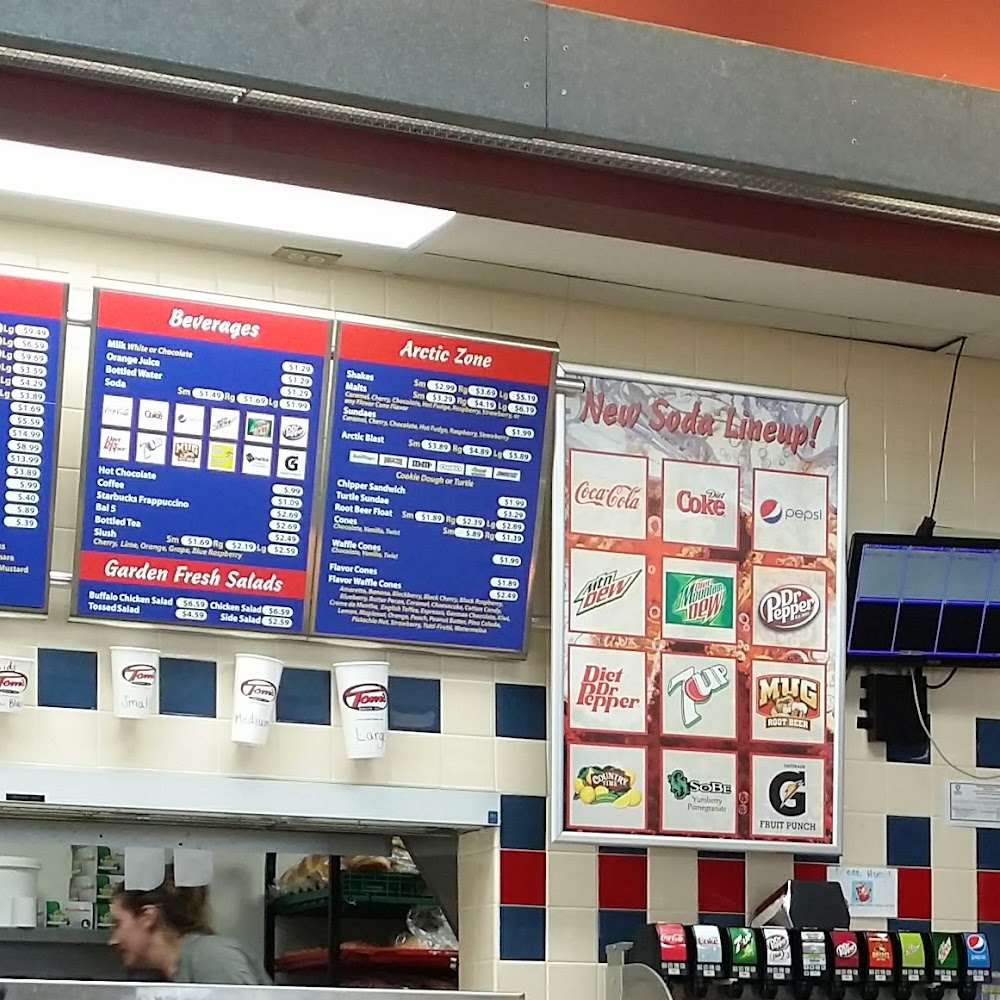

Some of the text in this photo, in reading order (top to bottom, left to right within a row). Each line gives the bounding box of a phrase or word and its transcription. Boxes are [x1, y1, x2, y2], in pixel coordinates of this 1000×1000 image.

[168, 308, 260, 340] Beverages
[107, 339, 311, 373] Milk Chocolate $1.29
[399, 340, 492, 369] Arctic Zone
[106, 353, 310, 385] Orange Juice $1.29
[346, 370, 456, 391] Shakes $2.99
[105, 365, 309, 397] Bottled Water $1.29
[105, 378, 308, 410] Soda $1.49 $1.69 $1.99
[345, 382, 495, 409] Malts $4.19
[18, 404, 41, 412] $1.69
[18, 417, 41, 426] $5.59
[343, 406, 532, 437] Sundaes $1.99
[579, 388, 822, 455] New Soda Lineup!
[12, 430, 41, 438] $14.99
[17, 443, 40, 451] $8.99
[341, 431, 529, 461] Arctic Blast $4.89 $5.89
[11, 455, 39, 464] $13.99
[14, 468, 37, 476] $3.89
[98, 466, 157, 481] Hot Chocolate
[396, 471, 444, 485] Cookie Dough
[20, 481, 38, 489] $.99
[97, 479, 300, 507] Coffee $1.09
[336, 479, 525, 507] Chipper Sandwich $1.99
[574, 480, 642, 511] Coca-Cola
[706, 488, 726, 500] Diet
[18, 493, 36, 501] $.40
[96, 491, 299, 519] Starbucks Frappuccino $2.69
[336, 491, 524, 518] Turtle Sundae $3.29
[676, 490, 726, 517] Coke
[17, 506, 35, 514] $.89
[333, 515, 357, 526] Cones
[334, 503, 394, 517] Root Beer Float
[785, 508, 822, 522] pepsi
[17, 519, 35, 527] $.39
[95, 515, 297, 543] Bottled Tea $2.49
[276, 522, 298, 531] $2.69
[94, 528, 296, 555] Slush $1.69 $2.59
[331, 539, 520, 565] Waffle Cones $1.99
[104, 559, 284, 593] Garden Fresh Salads
[329, 563, 377, 575] Flavor Cones
[328, 575, 516, 600] Flavor Waffle Cones $2.49
[781, 589, 802, 607] Dr
[88, 591, 262, 614] Buffalo Chicken Salad Chicken Salad
[88, 602, 290, 626] Tossed Salad $4.59 Side Salad $2.59
[767, 592, 815, 624] Pepper
[582, 665, 624, 684] Diet
[576, 682, 640, 713] Pepper
[596, 682, 619, 696] Dr
[758, 677, 819, 710] MUG
[767, 717, 809, 729] ROOT BEER
[592, 771, 629, 787] COUNTRY
[769, 771, 806, 817] G
[760, 820, 816, 831] FRUIT PUNCH
